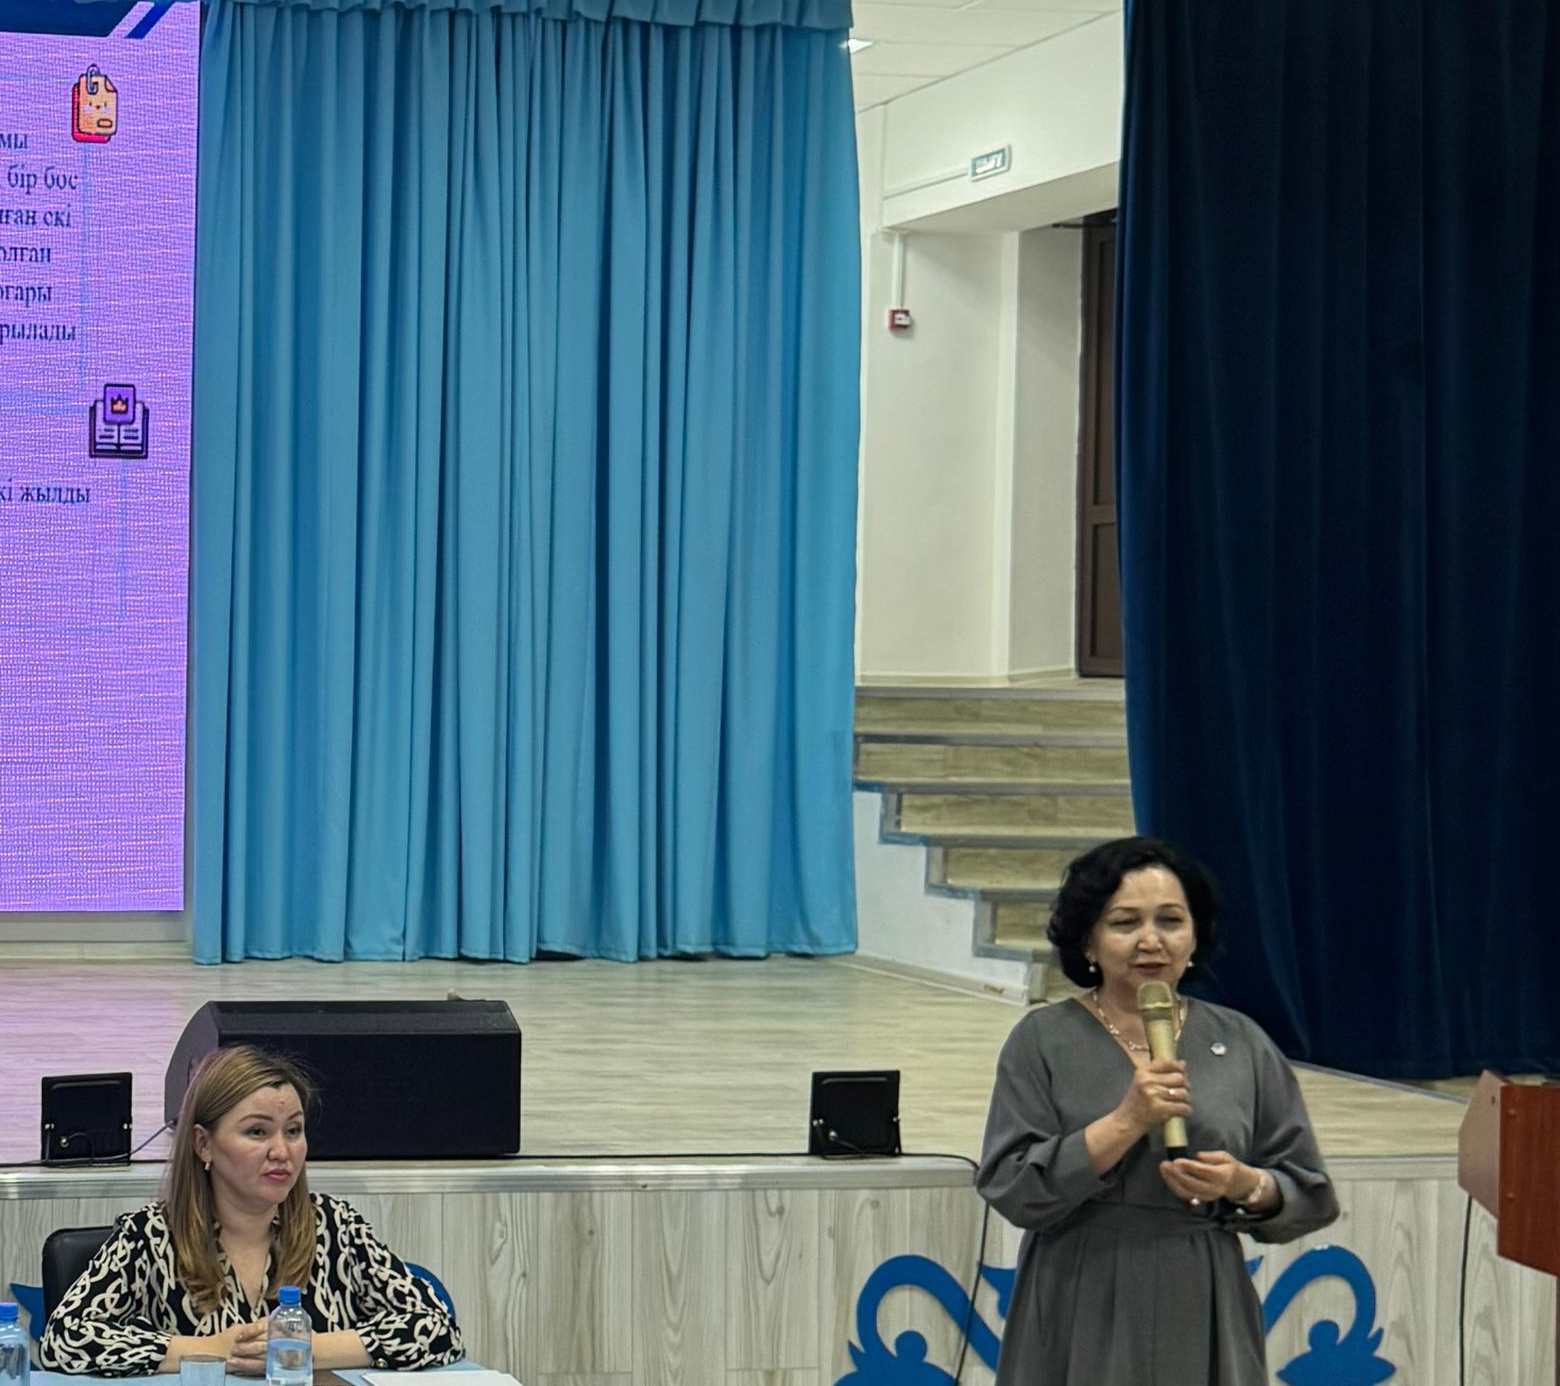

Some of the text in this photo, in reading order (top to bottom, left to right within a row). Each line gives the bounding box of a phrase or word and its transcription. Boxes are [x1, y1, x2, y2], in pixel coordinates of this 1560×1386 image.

[7, 164, 37, 194] бір
[44, 166, 78, 189] бос
[21, 486, 90, 504] жылды
